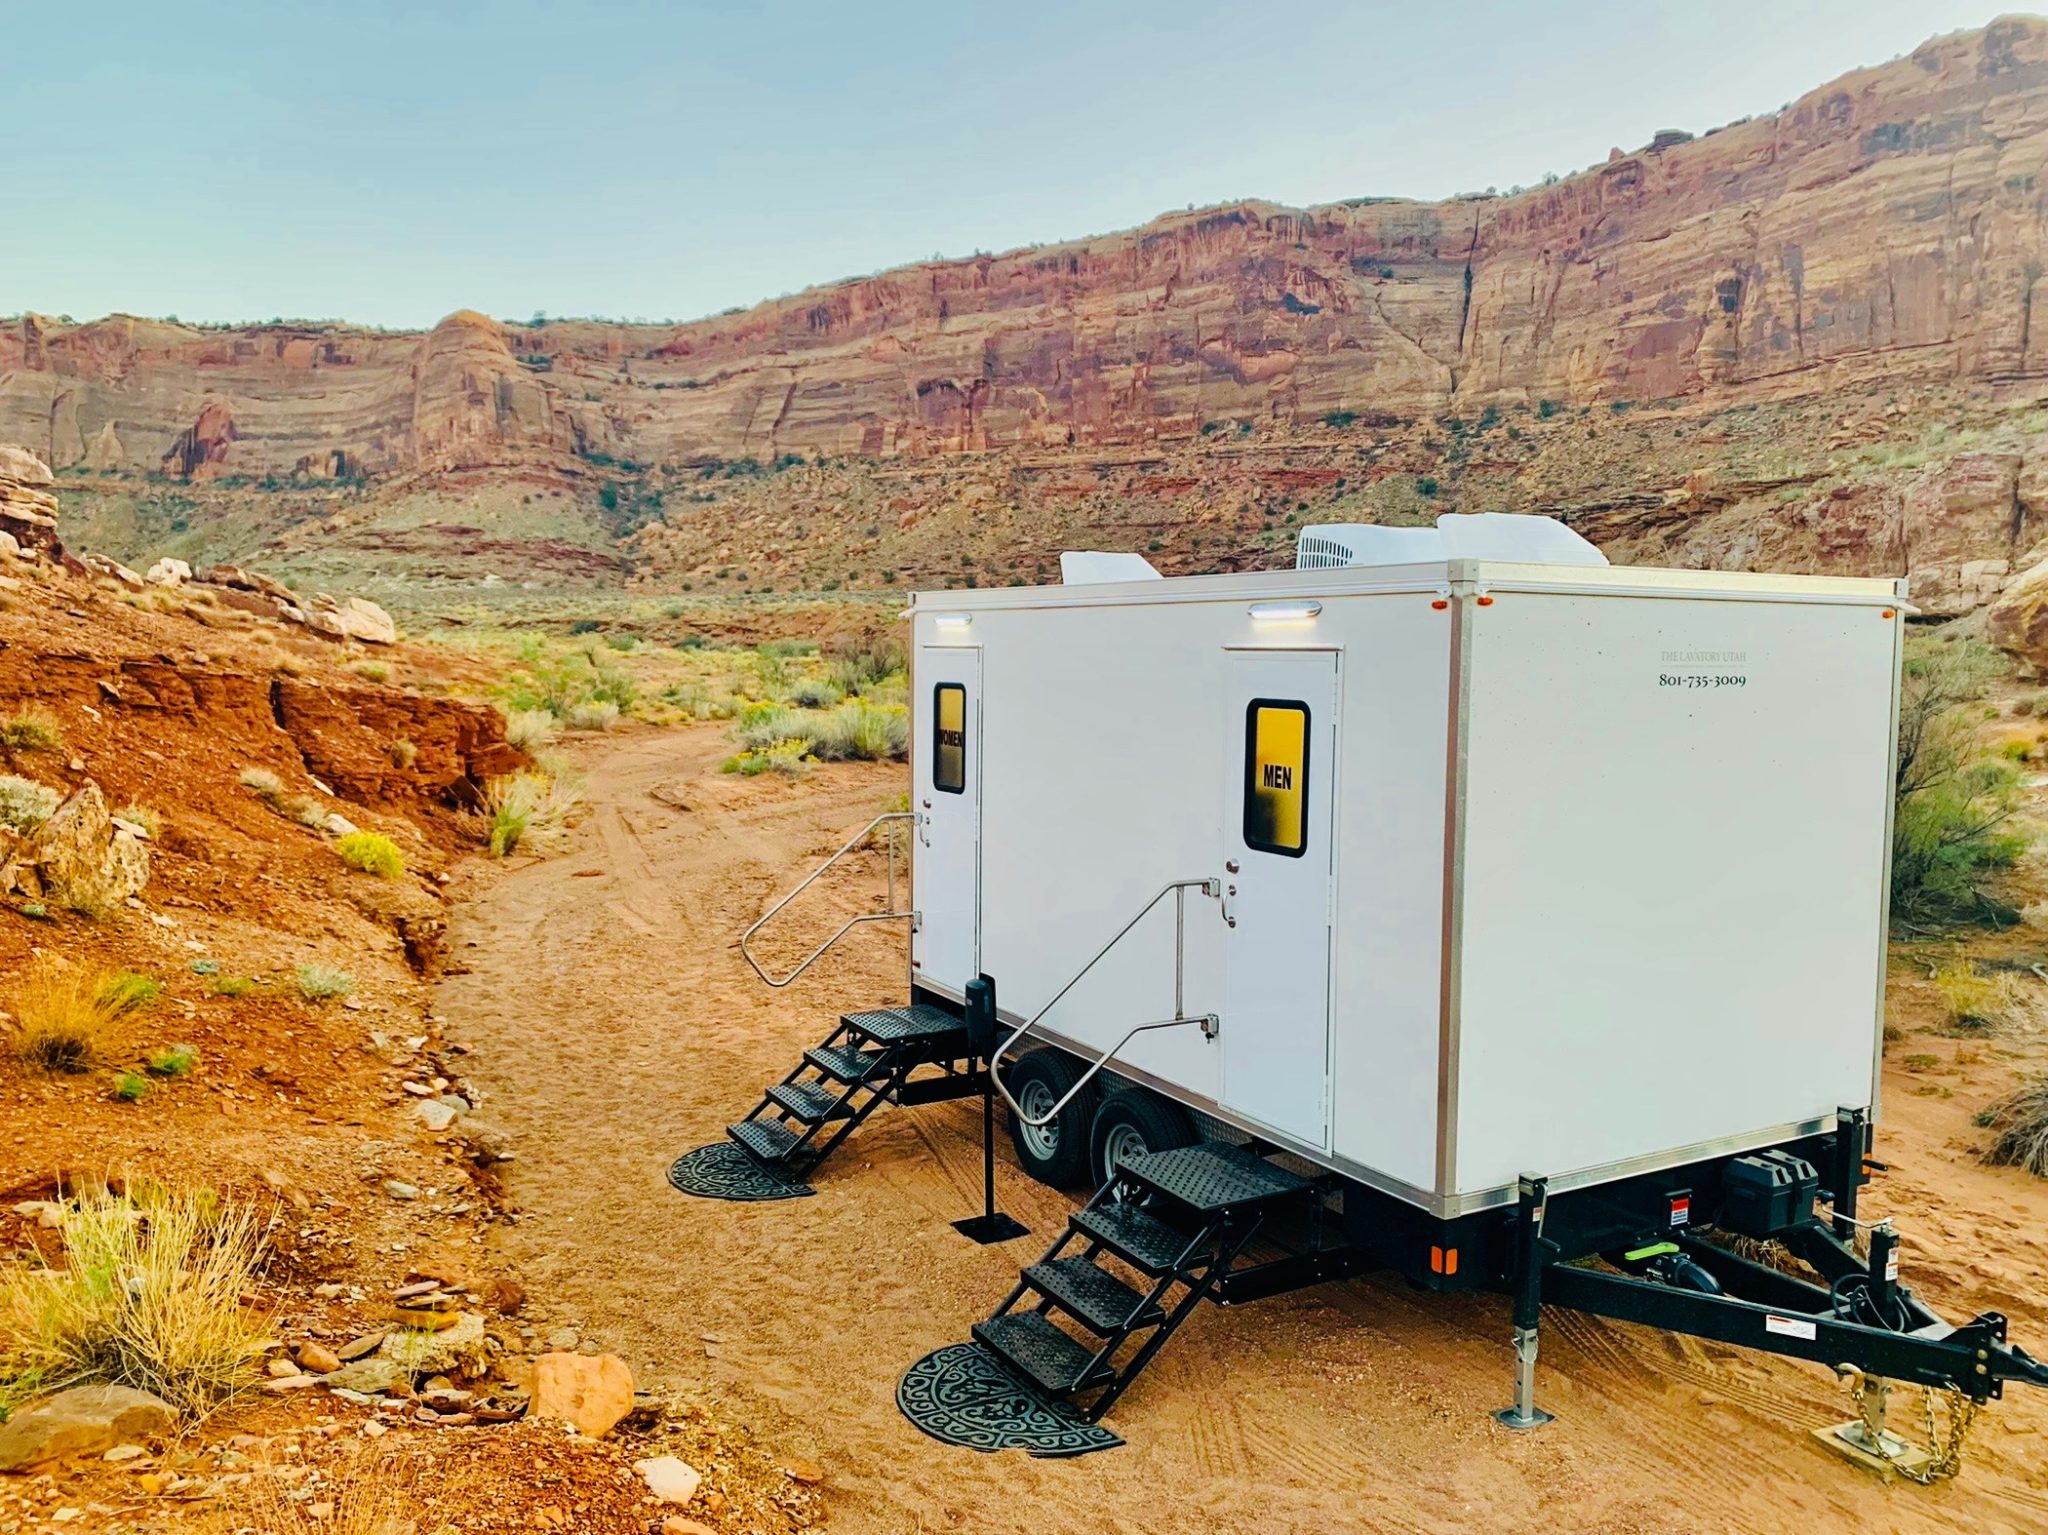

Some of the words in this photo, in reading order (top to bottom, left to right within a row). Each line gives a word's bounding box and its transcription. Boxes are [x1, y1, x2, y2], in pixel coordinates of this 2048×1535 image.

[1661, 651, 1679, 662] THE
[1680, 651, 1720, 662] LAVATORY
[1722, 651, 1746, 662] UTAH
[1659, 673, 1746, 688] 801-735-3009
[938, 729, 963, 747] WOMEN
[1263, 764, 1292, 790] MEN
